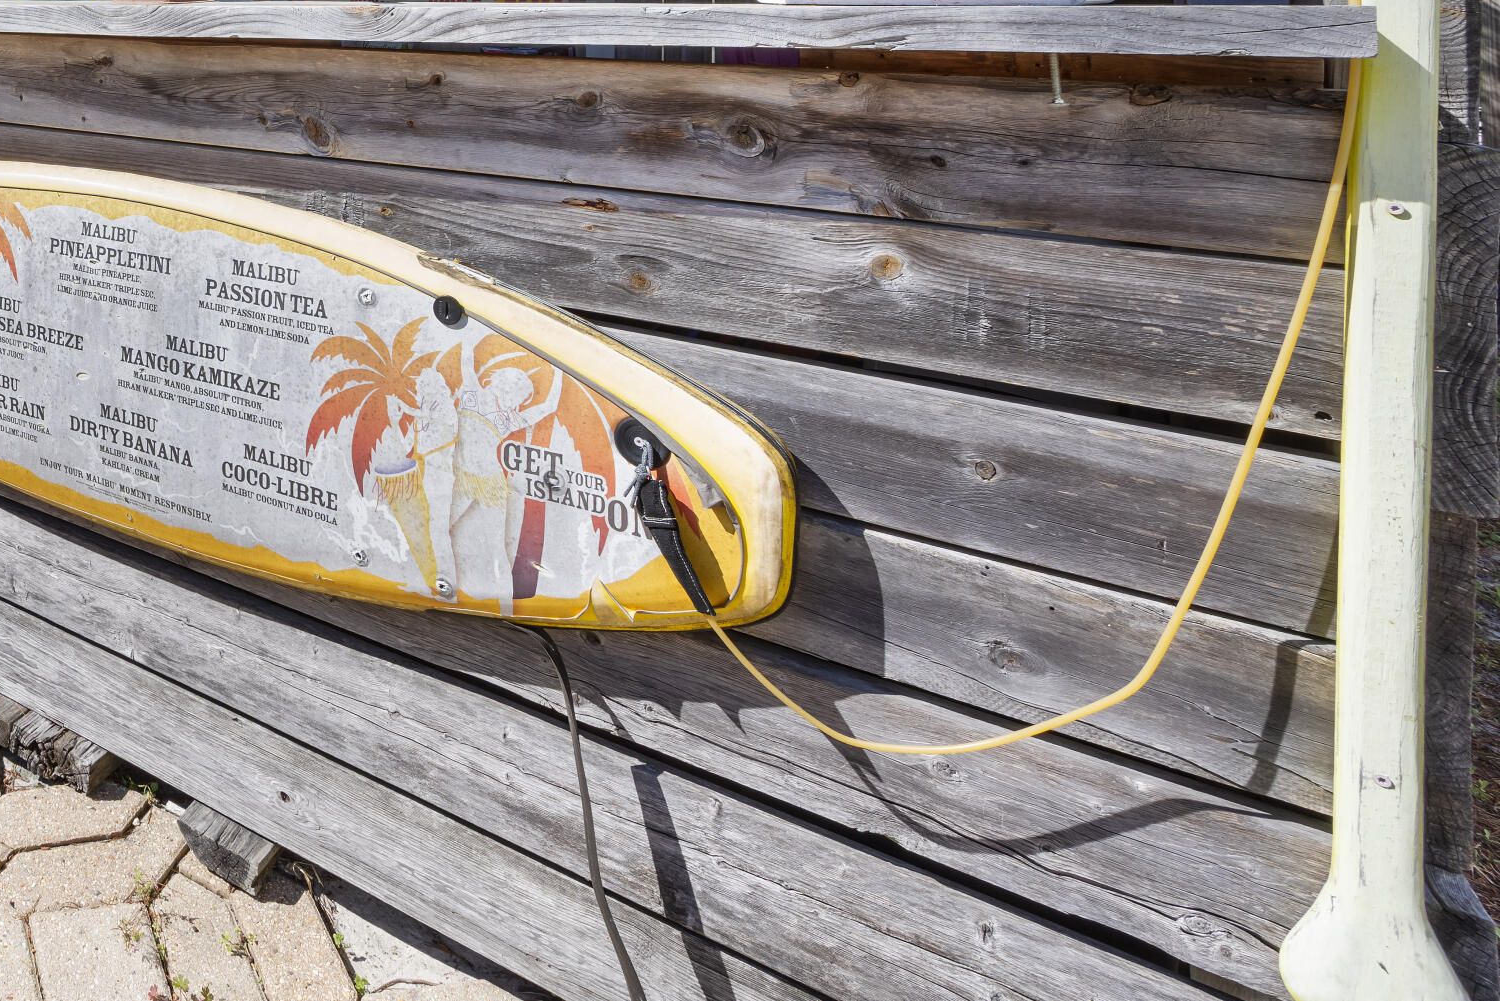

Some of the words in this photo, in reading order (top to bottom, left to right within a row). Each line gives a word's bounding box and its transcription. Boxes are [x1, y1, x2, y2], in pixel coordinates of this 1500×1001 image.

[81, 221, 137, 244] MALIBU
[50, 238, 171, 275] PINEAPPLETINI
[59, 273, 81, 284] HIRAM
[81, 277, 113, 290] WALKER
[114, 284, 140, 296] TRIPLE
[141, 289, 156, 299] SEC,
[73, 263, 99, 275] MALIBU
[102, 269, 142, 284] PINEAPPLE,
[232, 259, 300, 285] MALIBU
[58, 285, 72, 294] LIME
[73, 289, 92, 299] JUICE
[109, 296, 136, 308] ORANGE
[138, 302, 158, 312] JUICE
[205, 279, 287, 310] PASSION
[291, 294, 327, 319] TEA
[199, 300, 230, 313] MALIBU
[232, 306, 266, 321] PASSION
[268, 315, 295, 328] FRUIT,
[297, 321, 316, 331] ICED
[318, 325, 334, 335] TEA
[220, 319, 236, 328] AND
[237, 322, 286, 339] LEMON-LIME
[287, 333, 309, 344] SODA
[27, 322, 84, 350] BREEZE
[166, 334, 228, 362] MALIBU
[7, 350, 24, 360] JUICE
[121, 346, 180, 375] MANGO
[183, 361, 280, 400] KAMIKAZE
[118, 379, 141, 392] HIRAM
[142, 386, 175, 401] WALKER
[177, 396, 205, 410] TRIPLE
[206, 403, 220, 413] SEC
[221, 408, 237, 418] AND
[239, 412, 258, 422] LIME
[259, 417, 283, 430] JUICE
[134, 371, 162, 384] MALIBU
[164, 378, 193, 393] MANGO,
[193, 387, 230, 401] ABSOLUT
[232, 396, 264, 411] CITRON,
[0, 413, 27, 427] ABSOLUT
[9, 397, 45, 420] RAIN
[100, 403, 158, 432] MALIBU
[5, 427, 20, 437] LIME
[20, 432, 38, 443] JUICE
[70, 415, 119, 444] DIRTY
[123, 431, 193, 467] BANANA
[100, 445, 126, 459] MALIBU
[129, 452, 160, 470] BANANA,
[244, 444, 313, 477] MALIBU
[503, 442, 563, 478] GET
[566, 469, 605, 492] YOUR
[135, 469, 160, 482] CREAM
[222, 462, 338, 511] COCO-LIBRE
[40, 457, 62, 471] ENJOY
[64, 465, 83, 478] YOUR
[86, 473, 116, 489] MALIBU
[120, 484, 152, 501] MOMENT
[155, 495, 213, 523] RESPONSIBLY.
[222, 483, 254, 498] MALIBU
[256, 494, 294, 512] COCONUT
[296, 507, 313, 518] AND
[315, 512, 338, 526] COLA
[526, 478, 606, 514] ISLAND
[608, 500, 652, 539] O
